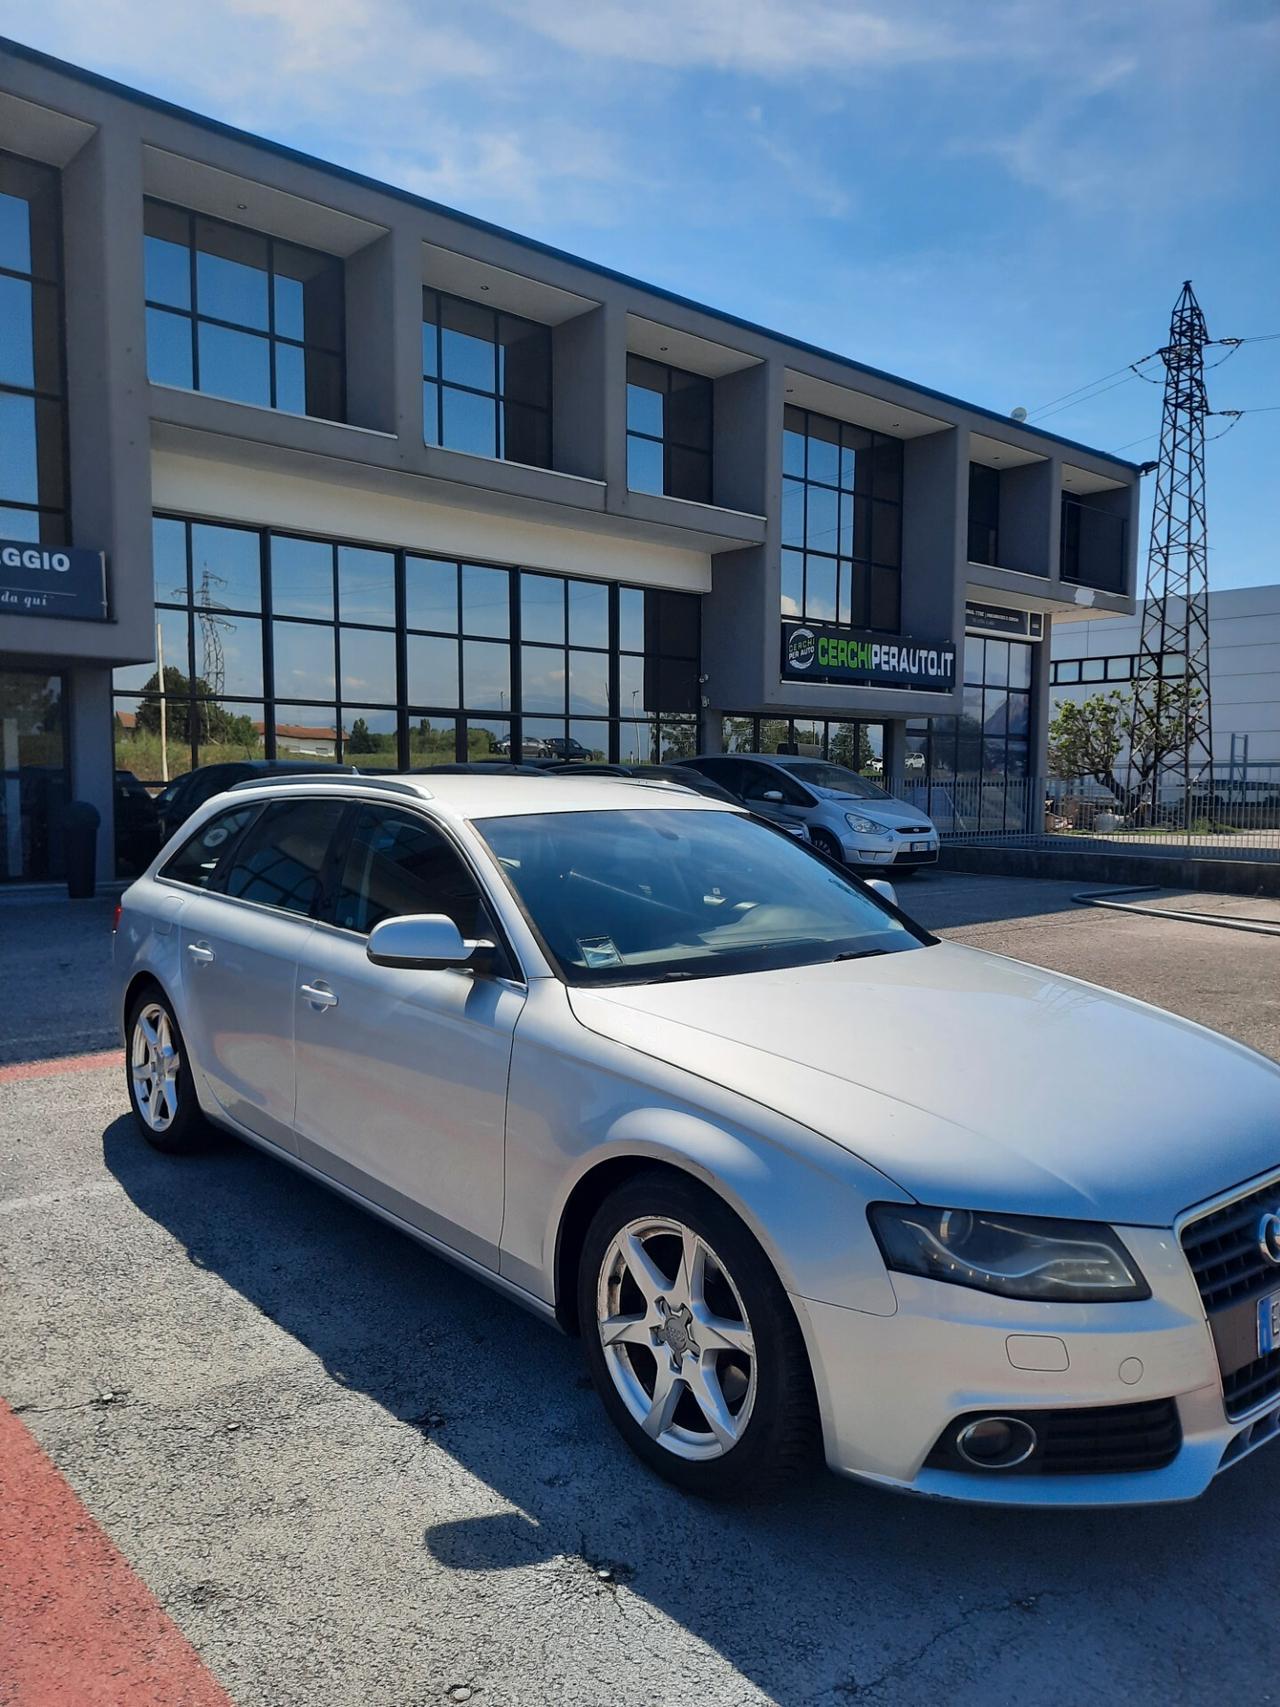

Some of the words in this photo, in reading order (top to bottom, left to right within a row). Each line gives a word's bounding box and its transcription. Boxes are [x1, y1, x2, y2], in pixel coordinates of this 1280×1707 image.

[0, 547, 70, 572] GGIO
[1, 590, 18, 603] da
[24, 594, 47, 608] qui
[788, 637, 815, 653] CERCHI
[788, 650, 800, 660] PER
[800, 646, 815, 657] AUTO
